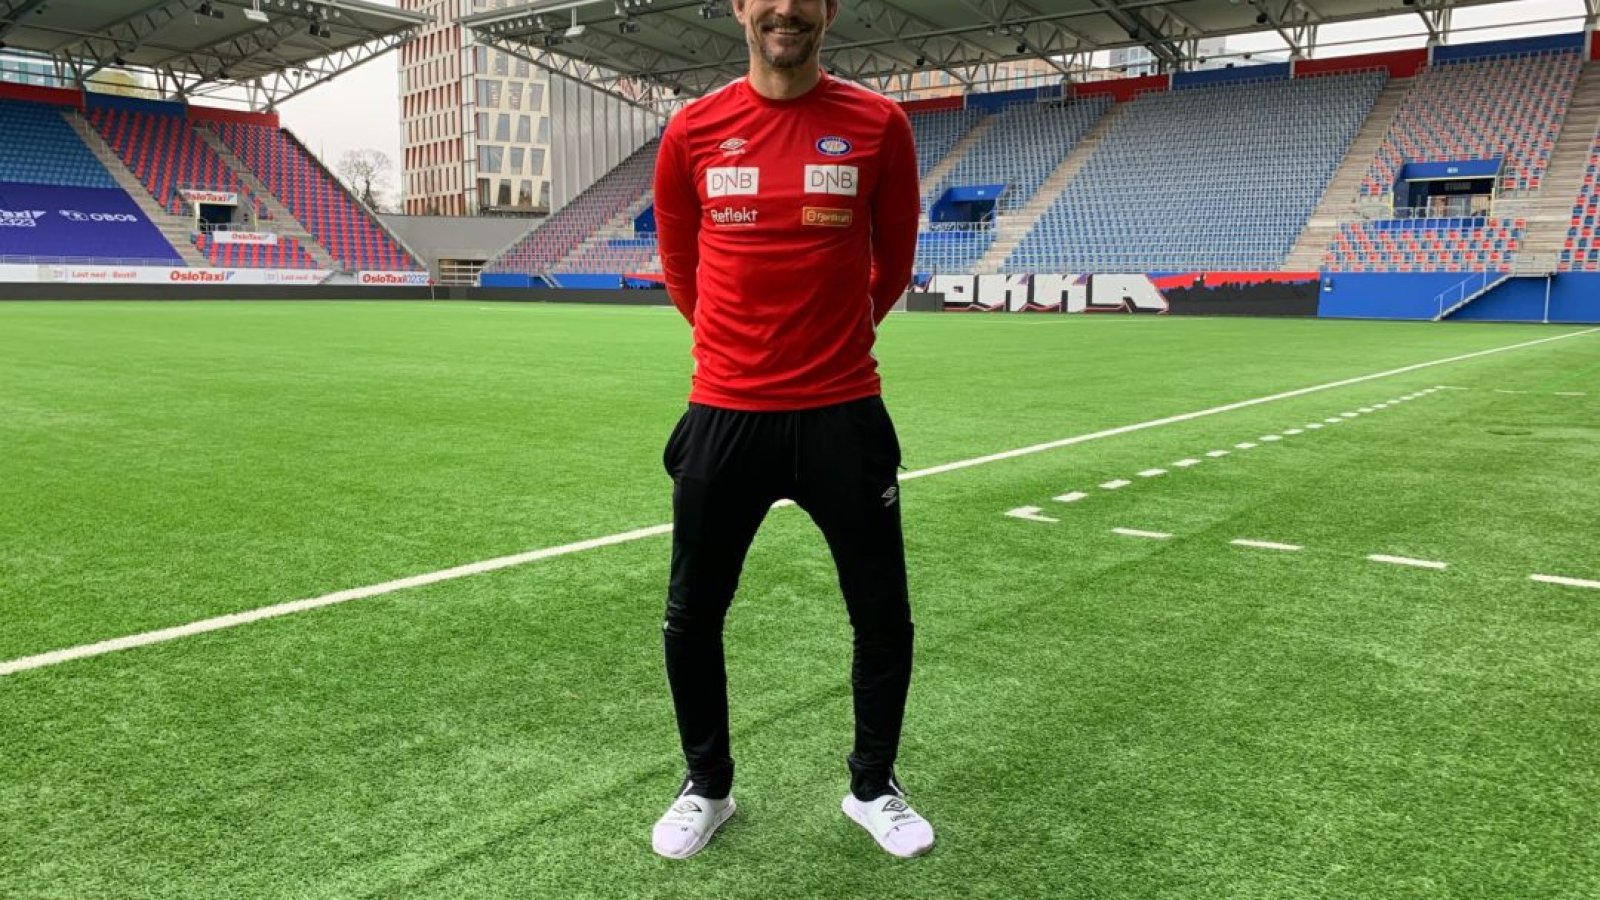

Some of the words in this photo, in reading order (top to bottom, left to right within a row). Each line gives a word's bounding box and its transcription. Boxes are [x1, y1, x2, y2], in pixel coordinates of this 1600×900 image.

[712, 168, 752, 194] DNB
[811, 165, 853, 194] DNB
[90, 212, 137, 223] OBOS
[711, 207, 759, 222] Reflekt
[170, 270, 225, 281] OsloTaxi
